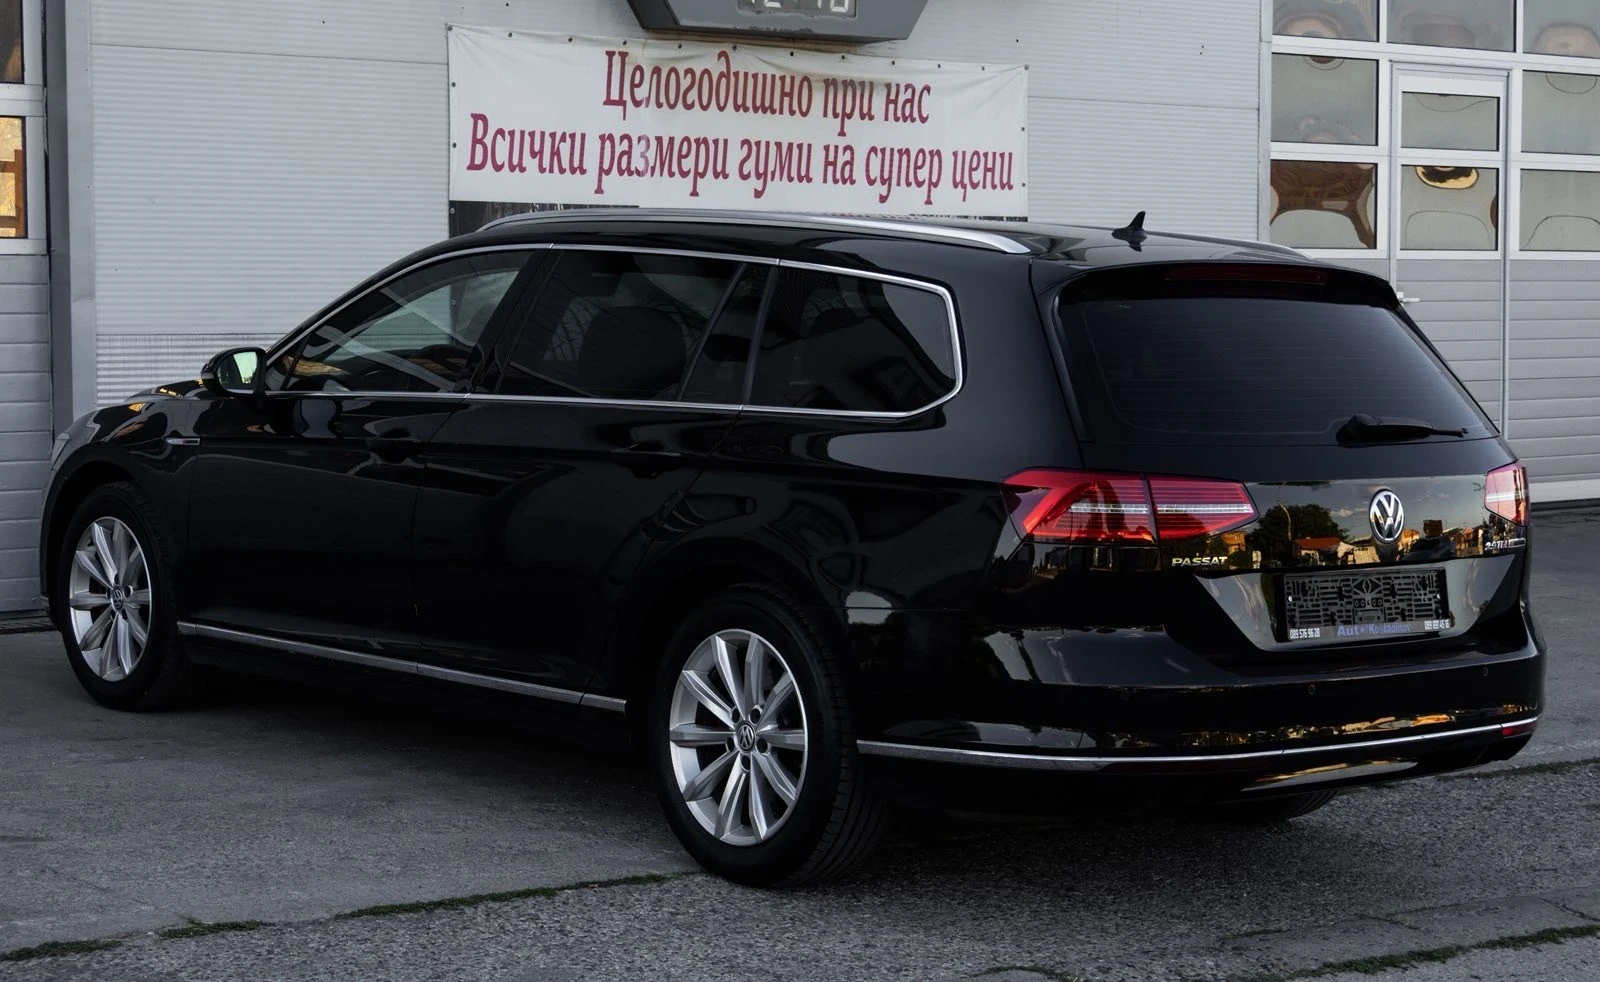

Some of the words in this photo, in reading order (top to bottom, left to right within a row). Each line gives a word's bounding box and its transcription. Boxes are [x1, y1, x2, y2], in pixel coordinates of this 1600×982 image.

[603, 50, 813, 121] Целогодишно
[822, 77, 875, 137] при
[883, 81, 932, 125] нас
[466, 112, 588, 176] Всички
[594, 132, 730, 197] размери
[738, 138, 813, 199] гуми
[822, 143, 856, 186] на
[864, 145, 943, 206] супер
[951, 150, 1015, 203] цени
[1171, 556, 1228, 567] PASSAT
